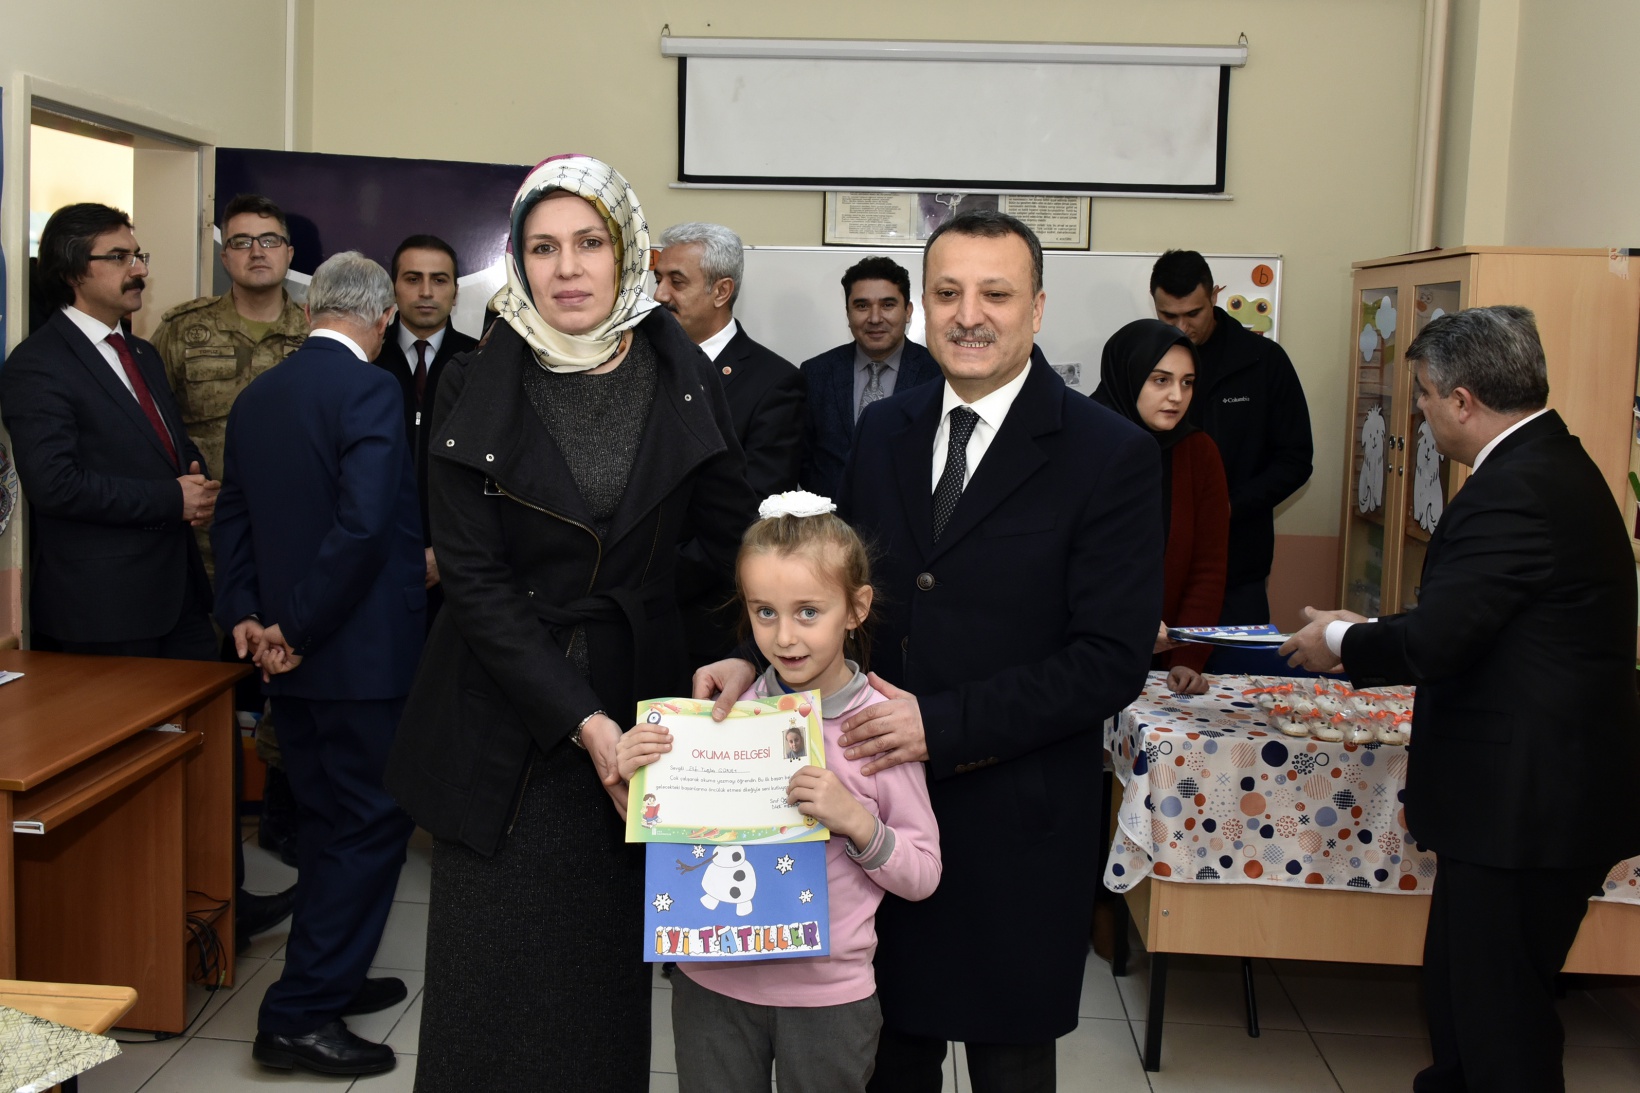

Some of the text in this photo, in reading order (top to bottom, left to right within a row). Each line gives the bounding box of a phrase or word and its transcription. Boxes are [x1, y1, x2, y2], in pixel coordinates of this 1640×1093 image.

[692, 746, 770, 760] OKUMA BELGESİ
[656, 921, 820, 956] İYİ TATİLLER
